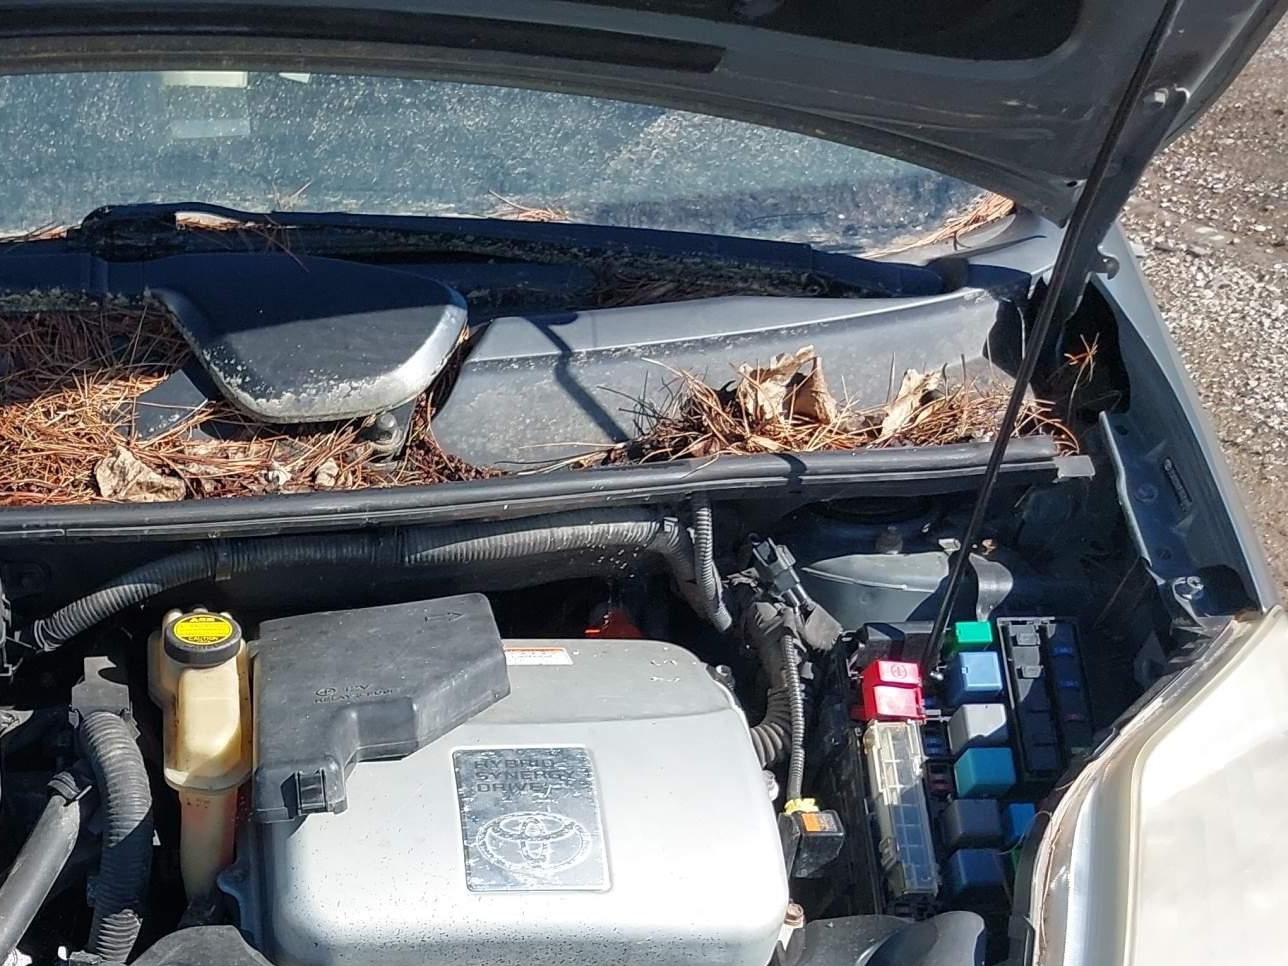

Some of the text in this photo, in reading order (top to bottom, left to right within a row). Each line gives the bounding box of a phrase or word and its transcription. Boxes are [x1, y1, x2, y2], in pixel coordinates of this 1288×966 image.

[474, 758, 555, 770] HYBRID
[475, 770, 576, 782] SYNERGY
[477, 782, 545, 793] DRIVE
